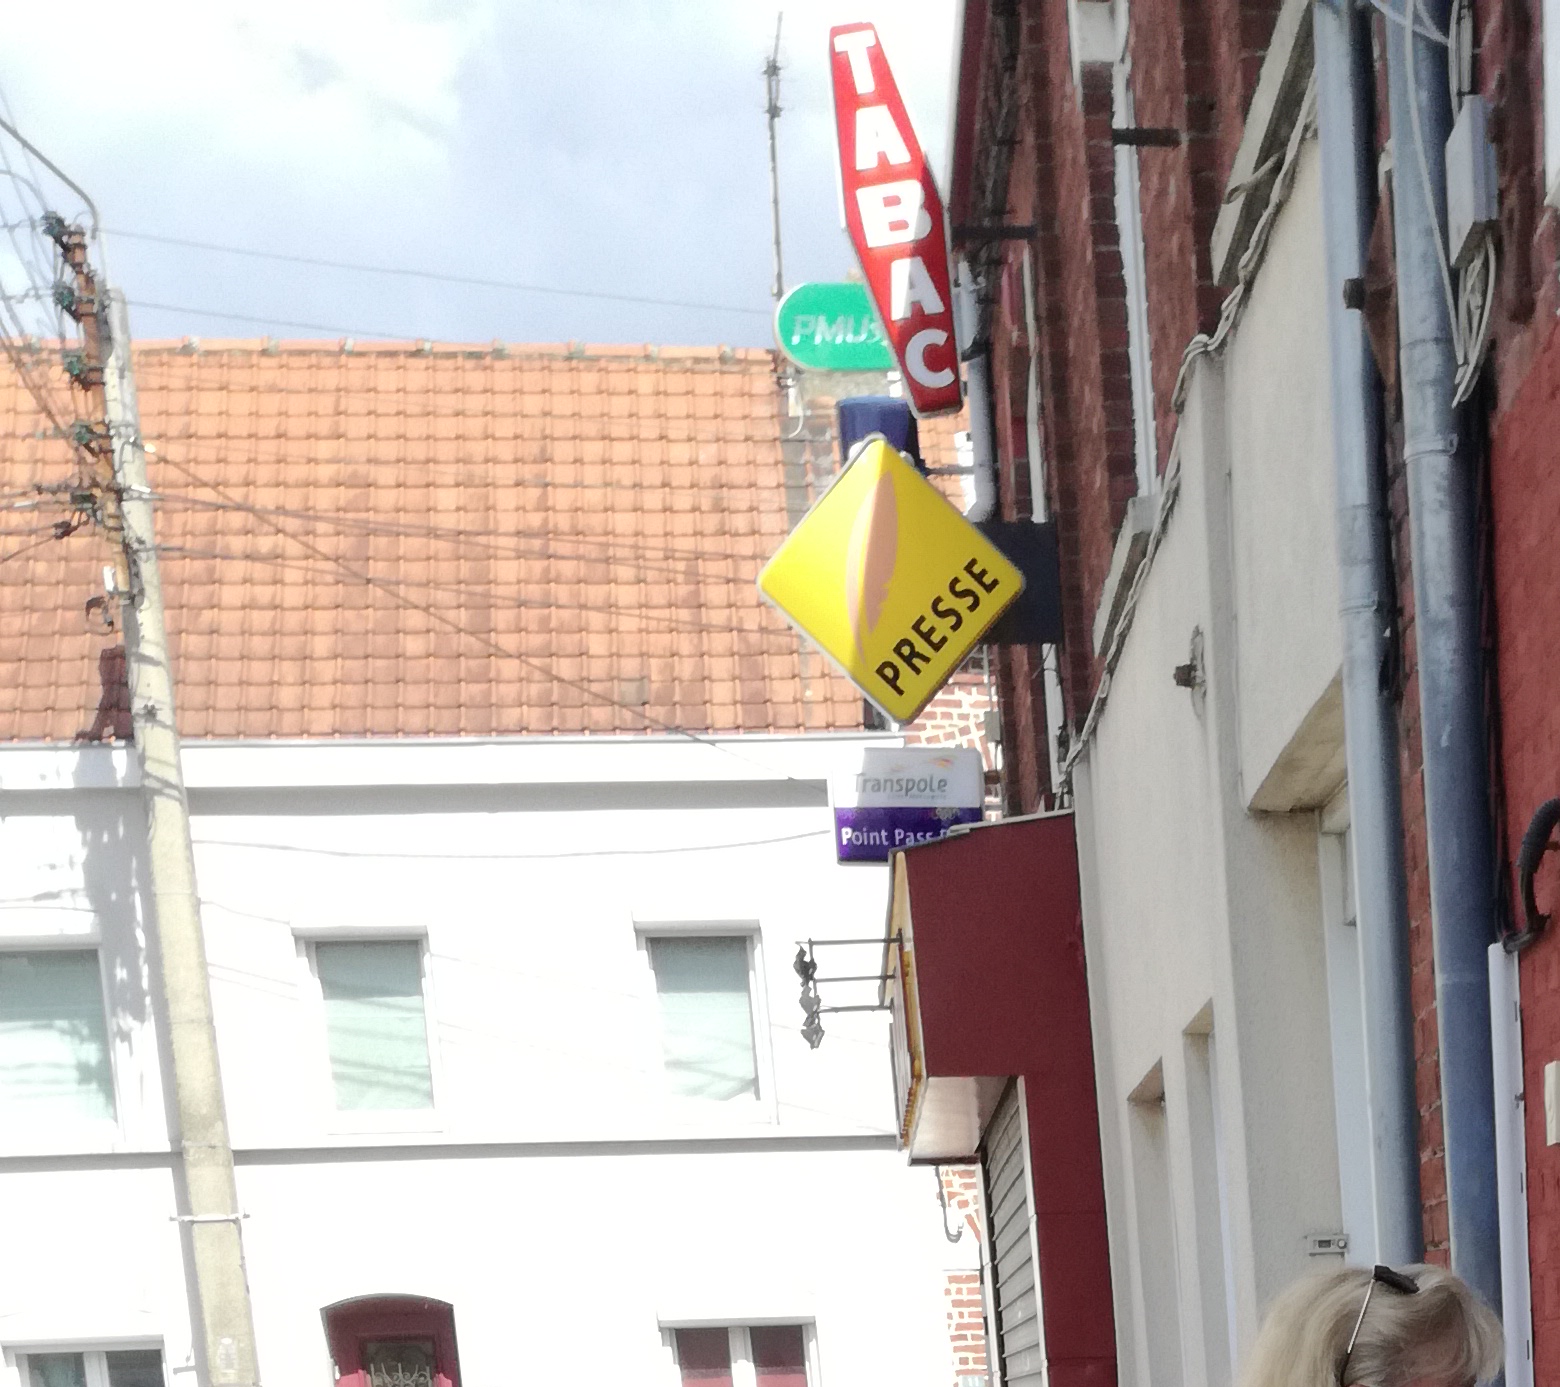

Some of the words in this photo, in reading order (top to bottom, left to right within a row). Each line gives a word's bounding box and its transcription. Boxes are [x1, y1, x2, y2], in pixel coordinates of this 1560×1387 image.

[833, 29, 955, 389] TABAC
[791, 314, 869, 346] PMU
[875, 557, 1000, 697] PRESSE
[854, 773, 948, 797] Transpole
[841, 826, 889, 846] Point
